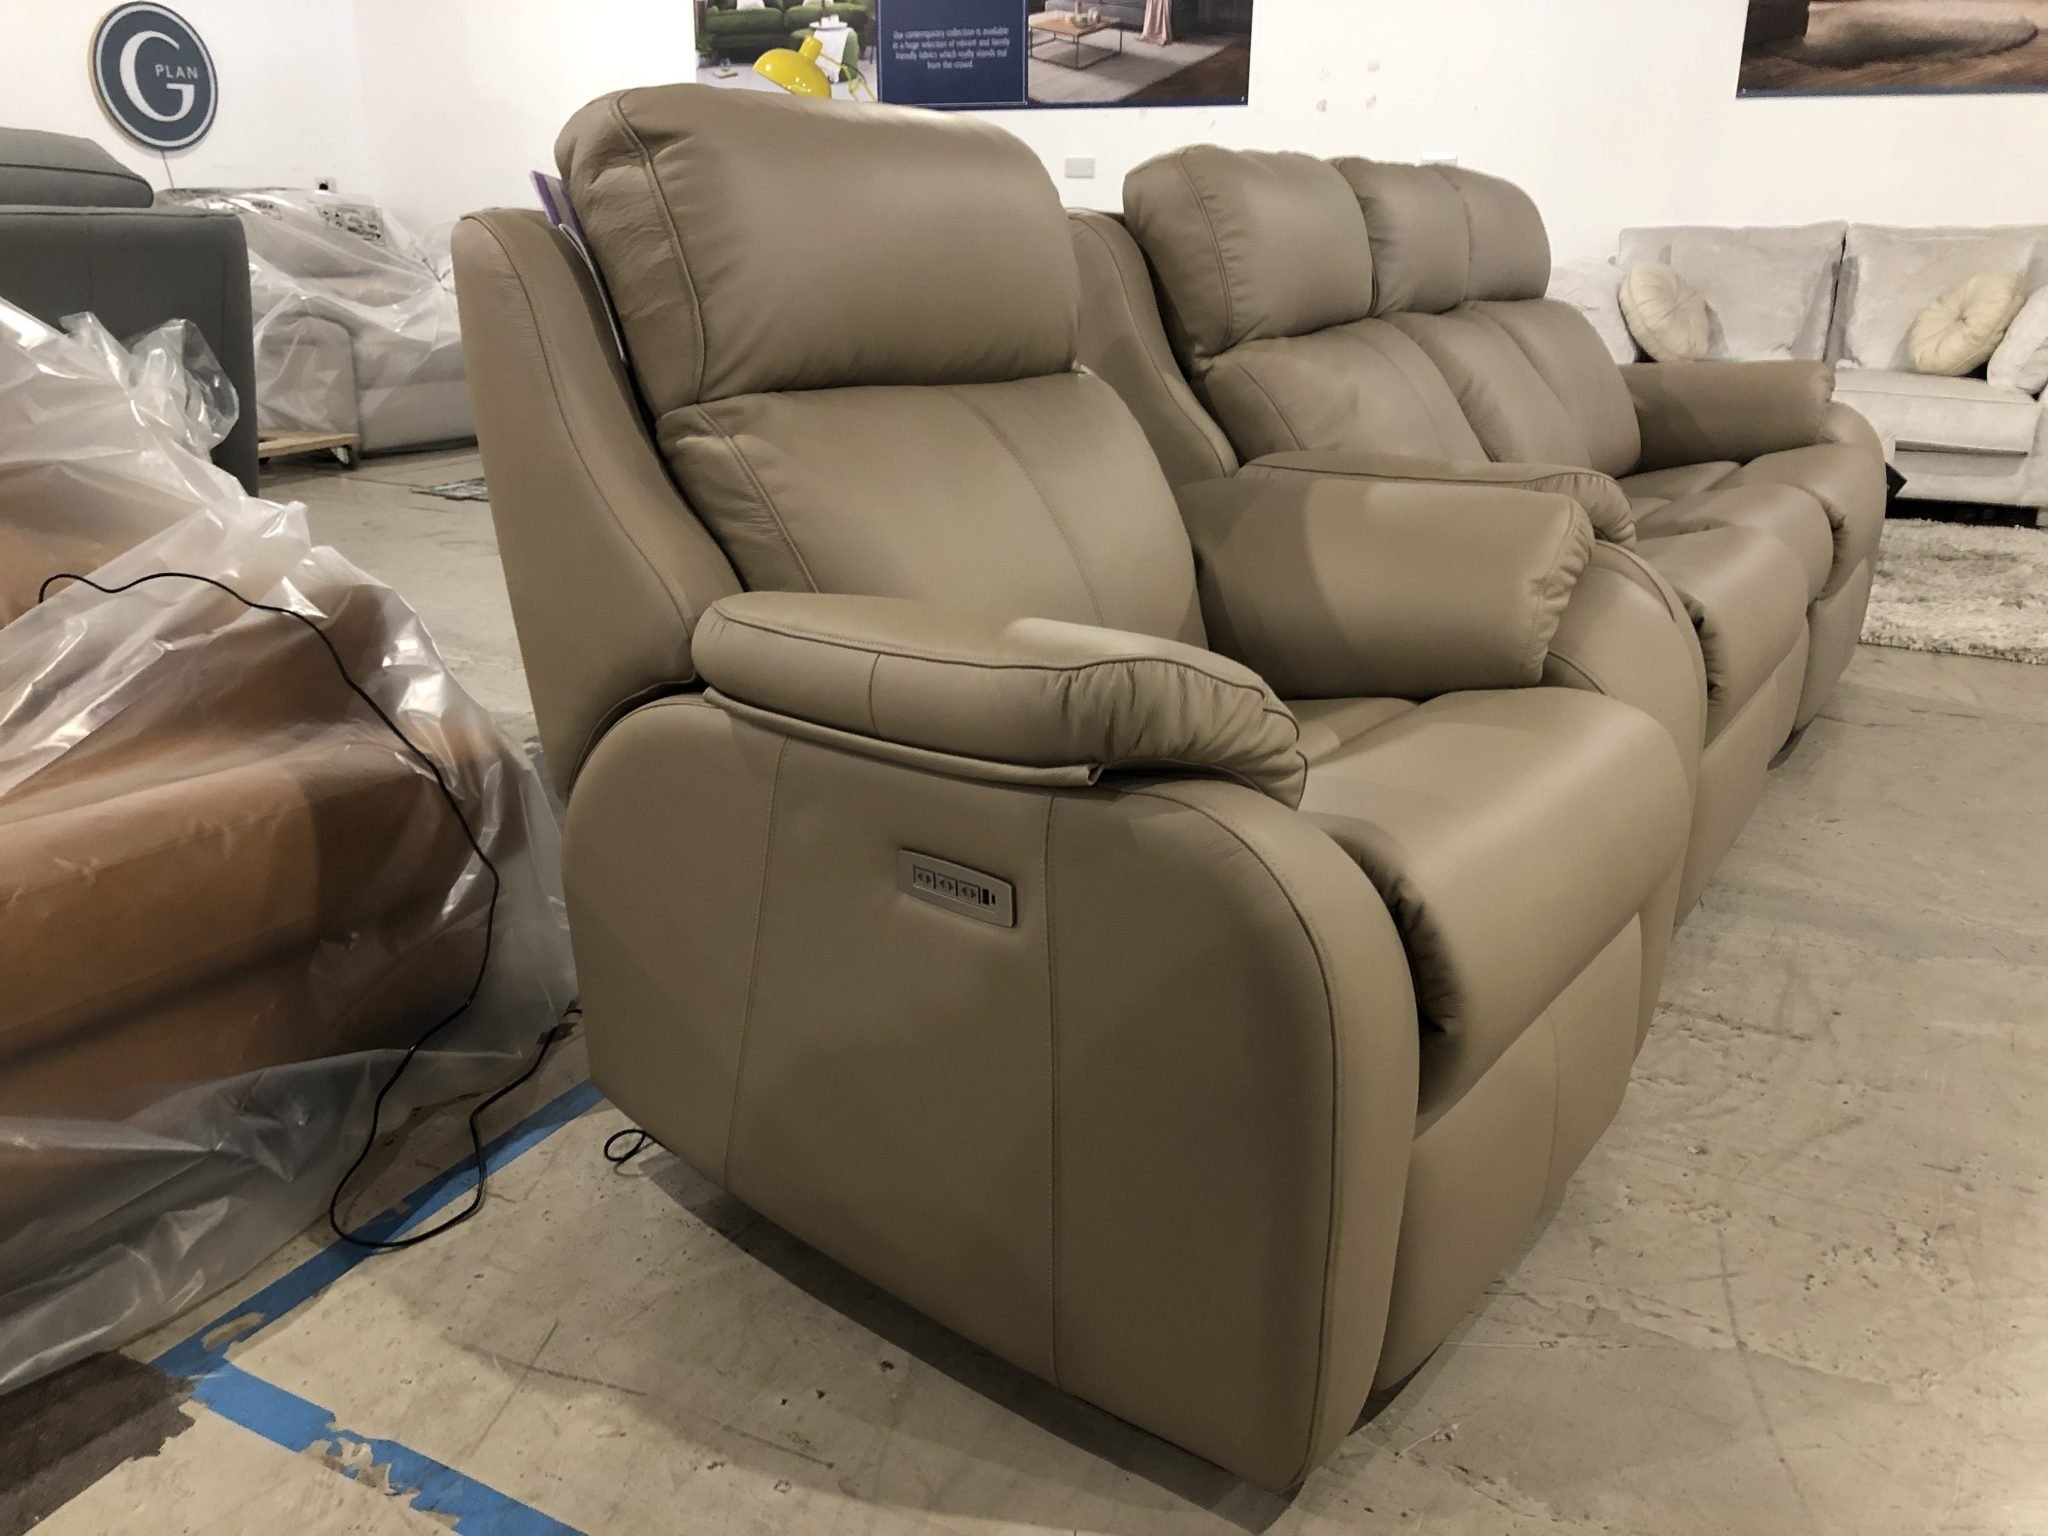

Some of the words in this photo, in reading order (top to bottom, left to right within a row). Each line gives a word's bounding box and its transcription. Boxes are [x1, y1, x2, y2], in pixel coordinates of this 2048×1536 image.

[905, 30, 944, 41] contemporary
[946, 27, 974, 37] collection
[983, 26, 1009, 36] available
[905, 41, 919, 50] huge
[921, 40, 947, 49] selection
[949, 39, 955, 48] of
[979, 37, 990, 46] and
[992, 37, 1010, 48] family
[895, 51, 917, 60] friendly
[939, 49, 956, 58] which
[958, 48, 974, 59] really
[155, 64, 198, 79] PLAN
[927, 60, 941, 69] from
[943, 60, 952, 69] the
[120, 30, 195, 122] G
